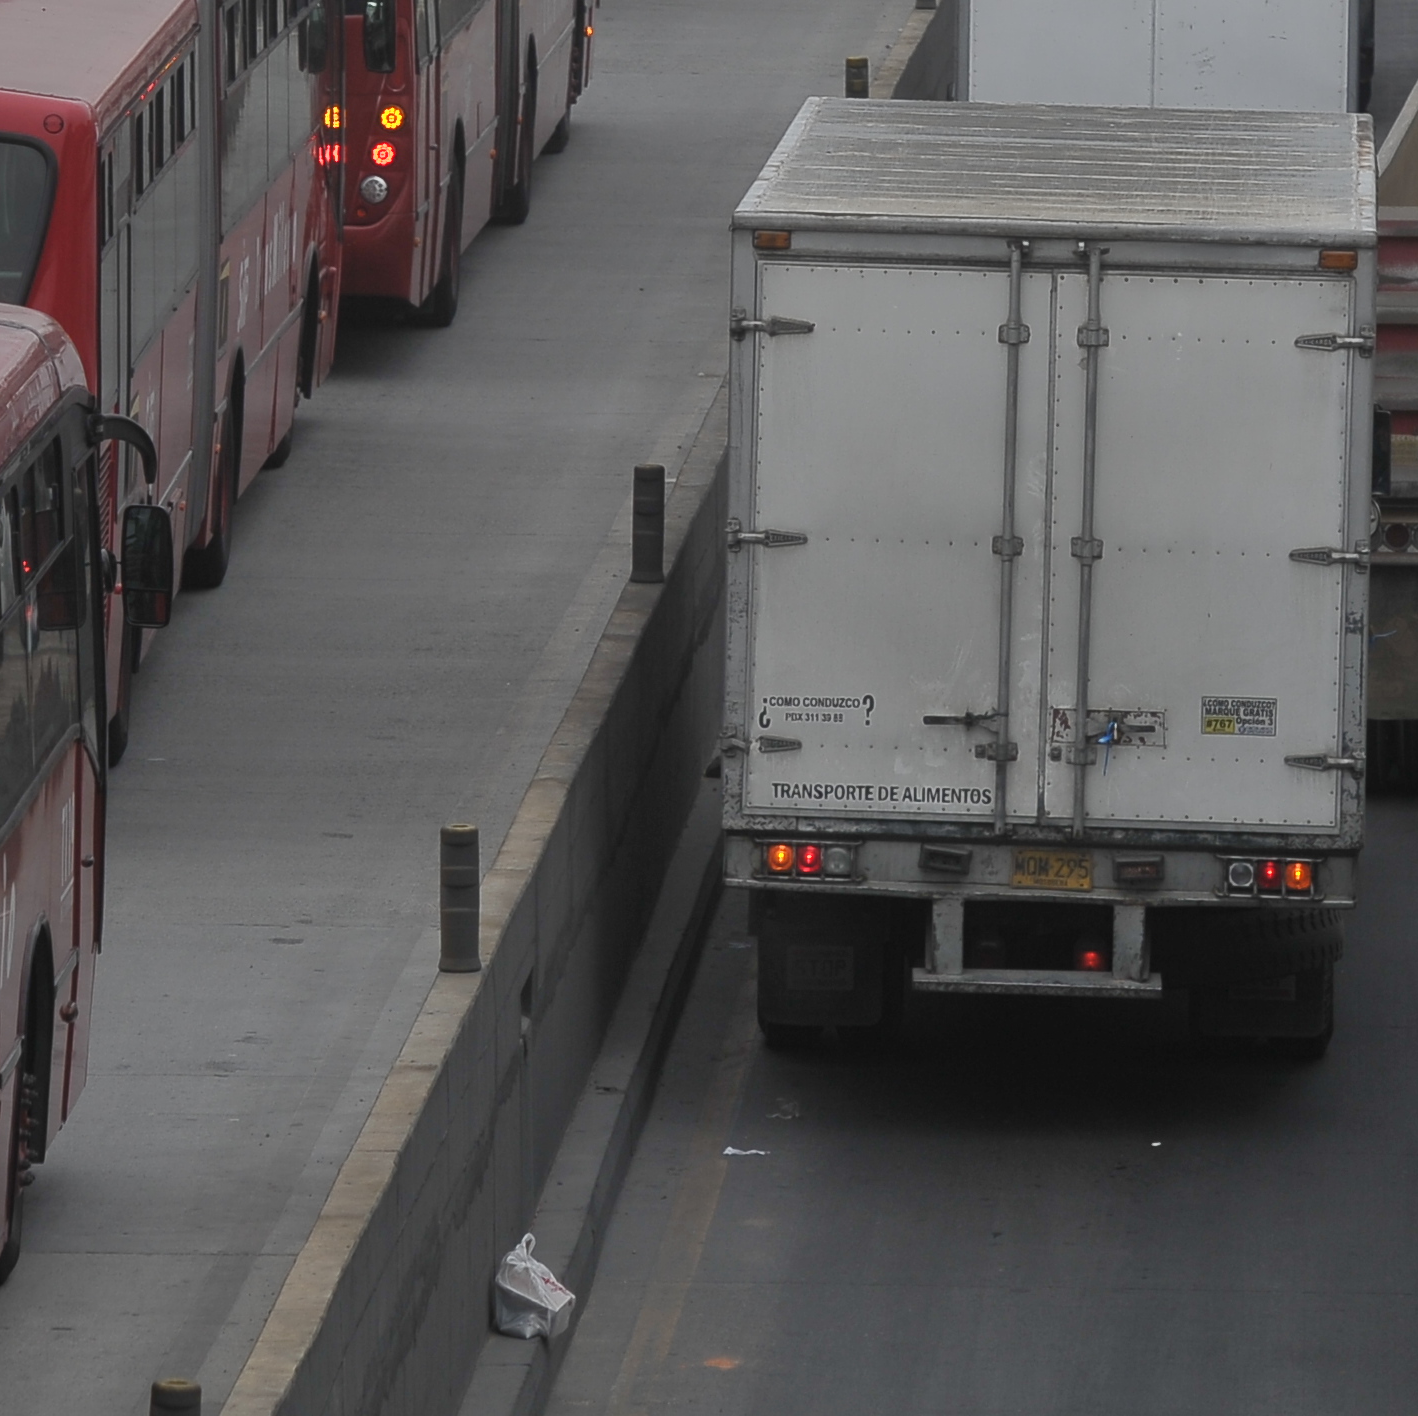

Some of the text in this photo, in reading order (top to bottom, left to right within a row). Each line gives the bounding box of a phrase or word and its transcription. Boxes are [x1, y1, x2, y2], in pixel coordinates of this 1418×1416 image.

[805, 713, 819, 722] 311
[1205, 707, 1274, 718] MARQUE GRATIS
[1206, 717, 1273, 732] #767 Opción 3
[771, 781, 992, 805] TRANSPORTE DE ALIMENTOS
